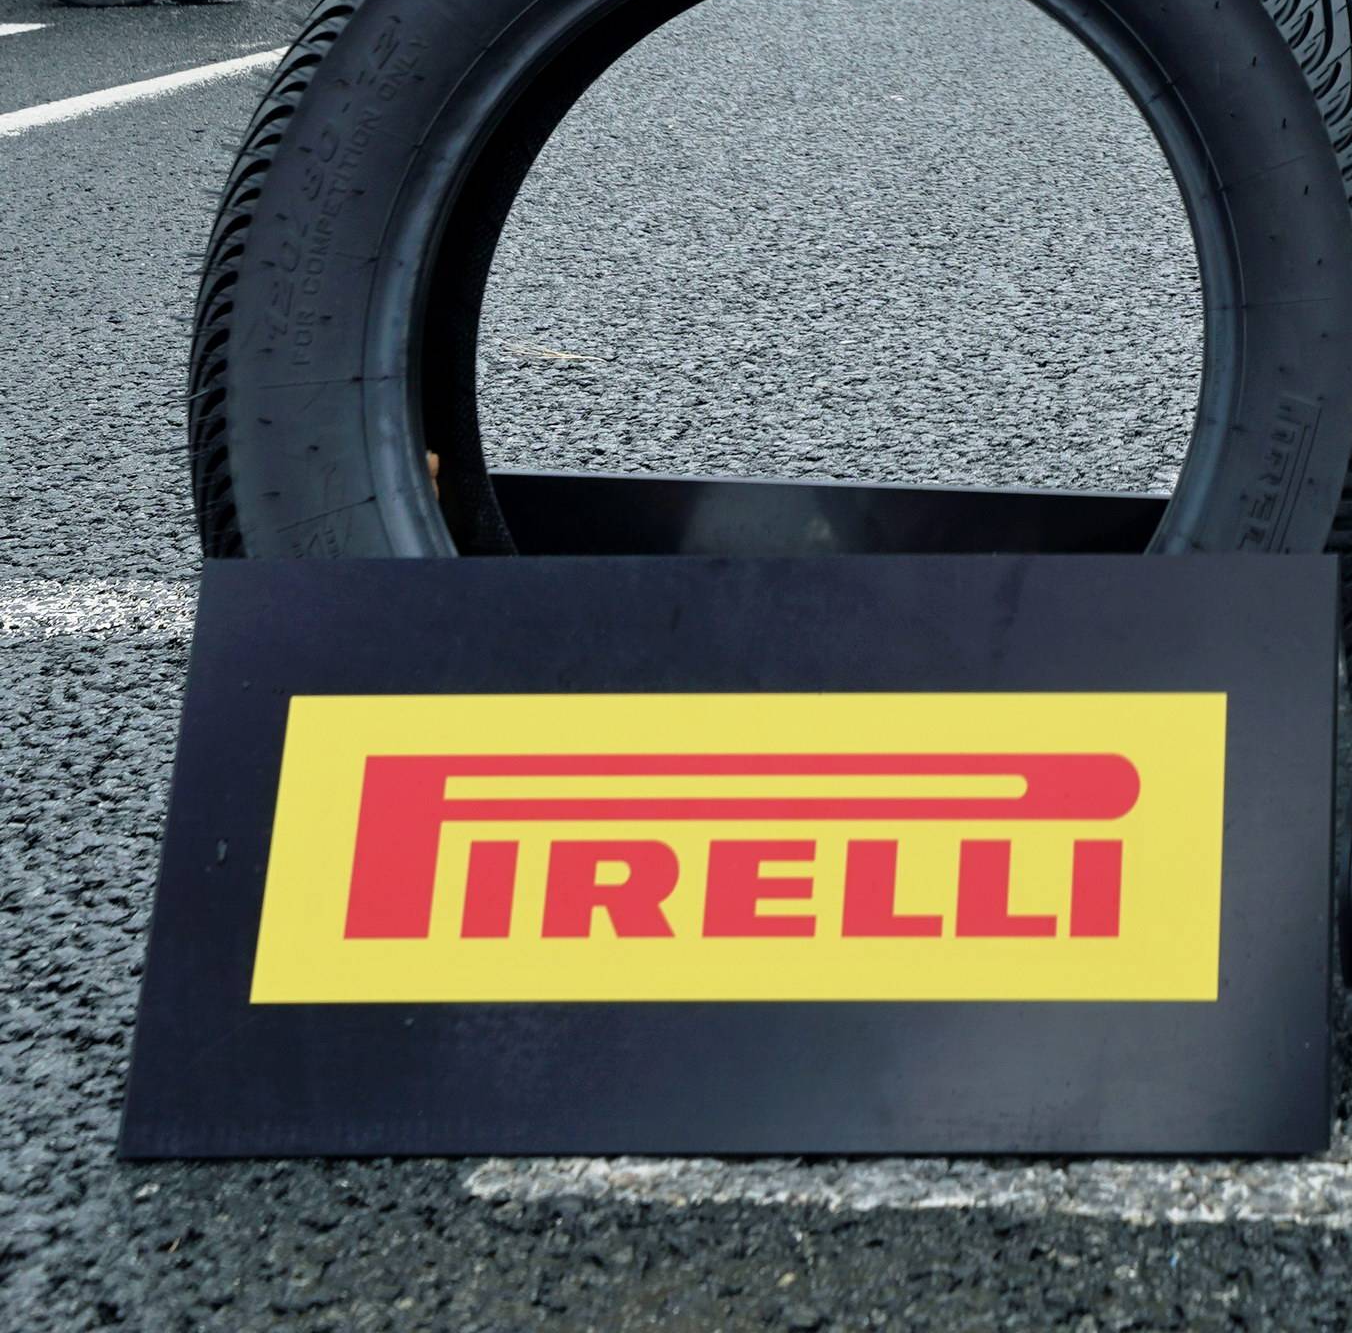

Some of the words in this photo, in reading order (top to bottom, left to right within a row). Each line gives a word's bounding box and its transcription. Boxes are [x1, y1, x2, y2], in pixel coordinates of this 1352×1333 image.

[376, 40, 430, 102] ONLY
[302, 108, 383, 296] COMPETITION
[292, 309, 317, 367] FOR
[343, 753, 1141, 940] PIRELLI
